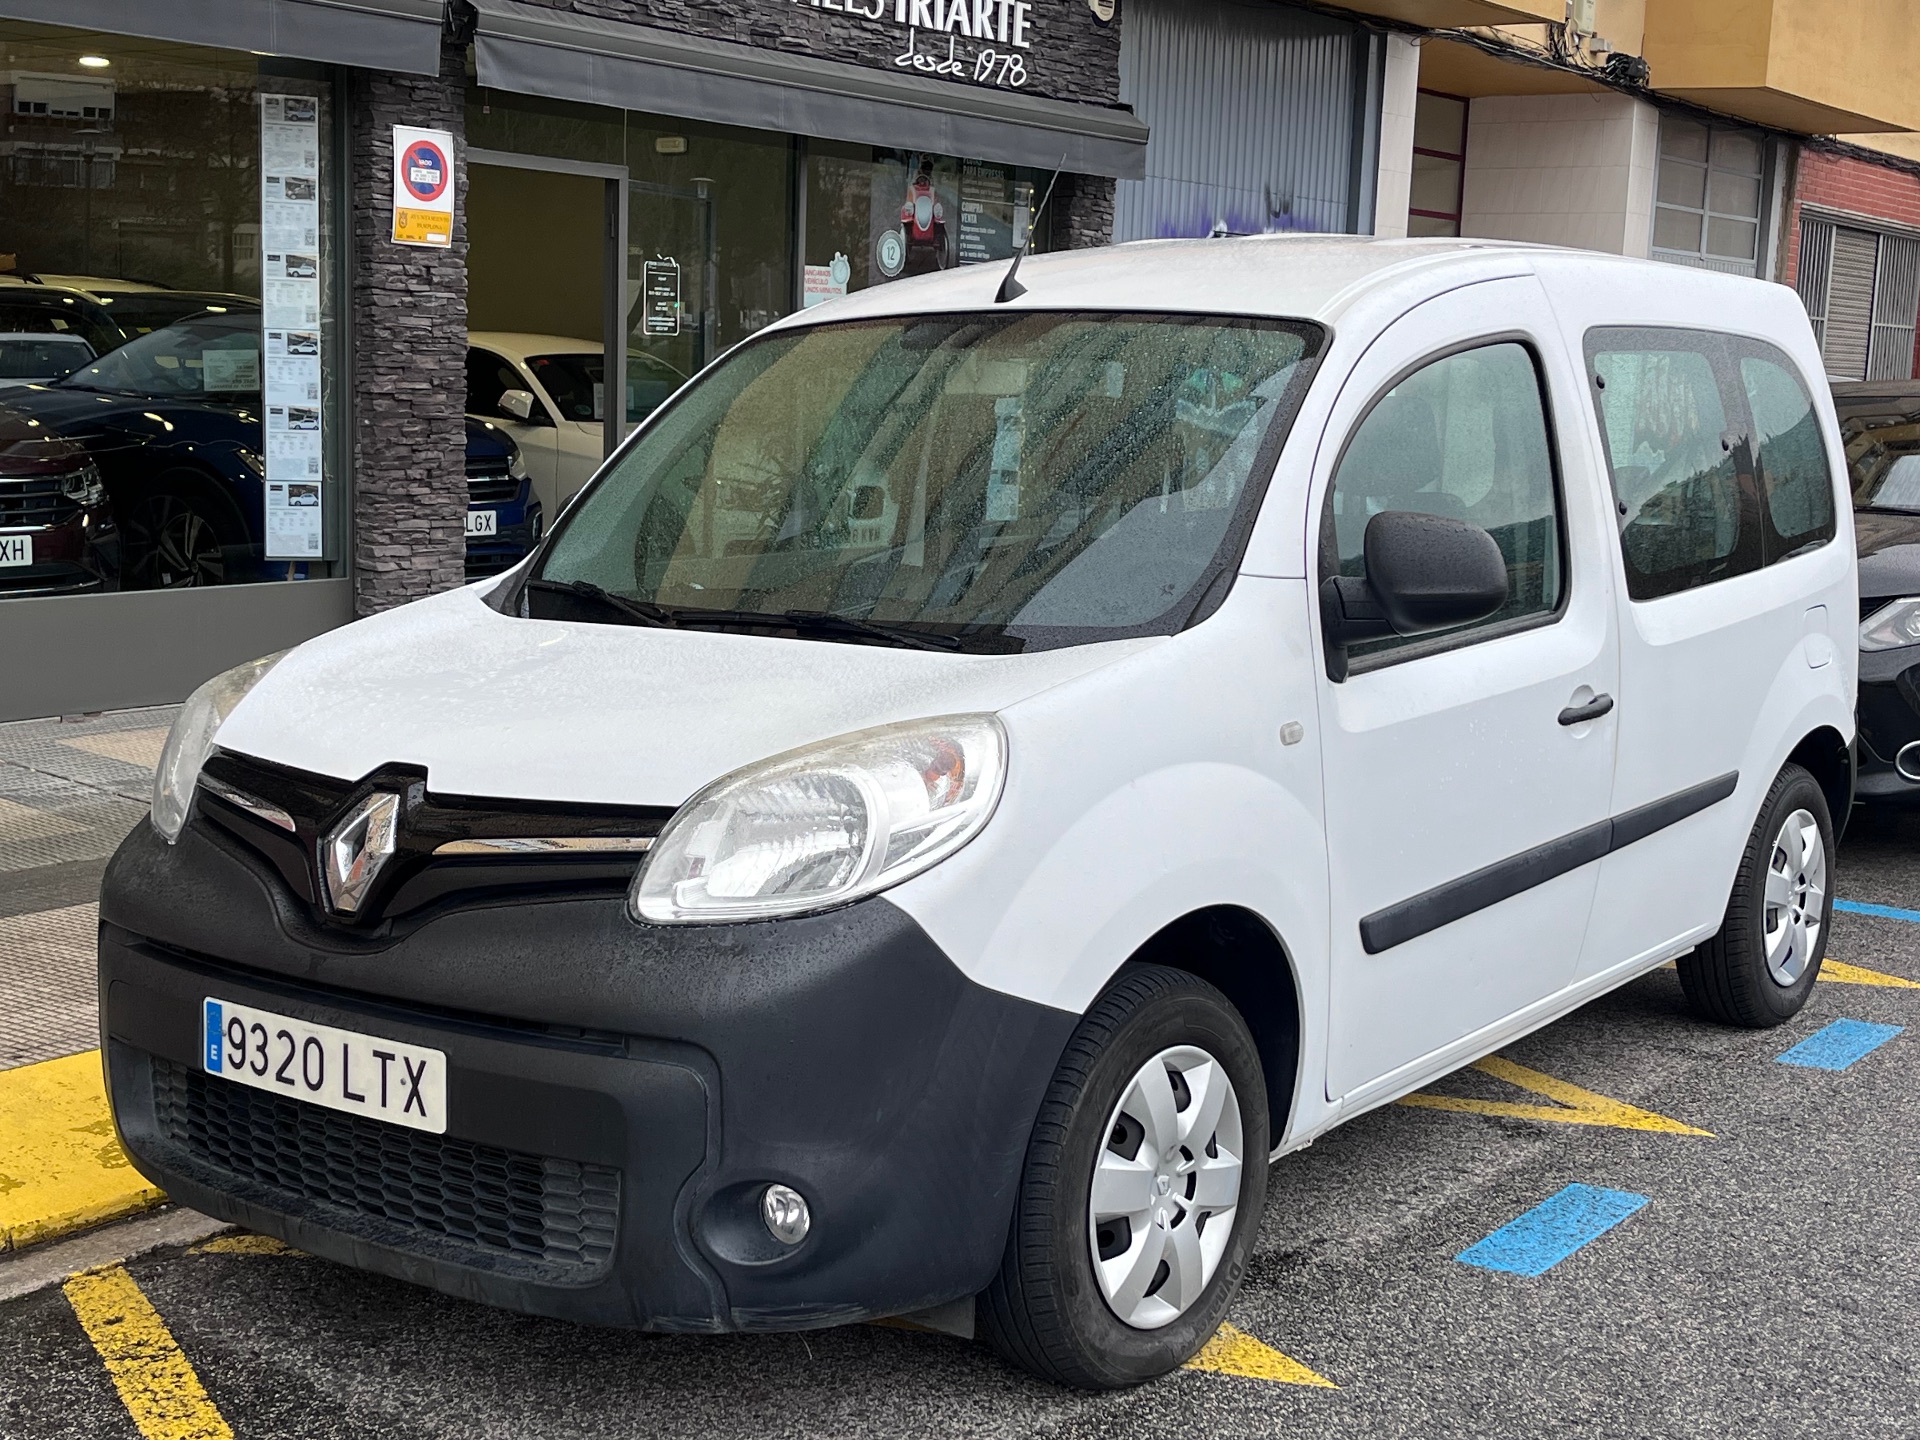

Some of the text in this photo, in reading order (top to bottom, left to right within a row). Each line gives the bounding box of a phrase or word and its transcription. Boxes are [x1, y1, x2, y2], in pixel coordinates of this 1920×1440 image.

[895, 27, 1027, 86] desde 1978
[418, 158, 433, 166] VADO
[886, 245, 896, 261] 12
[466, 514, 492, 533] LGX
[210, 1044, 218, 1060] E
[227, 1016, 427, 1118] 9320 LTX
